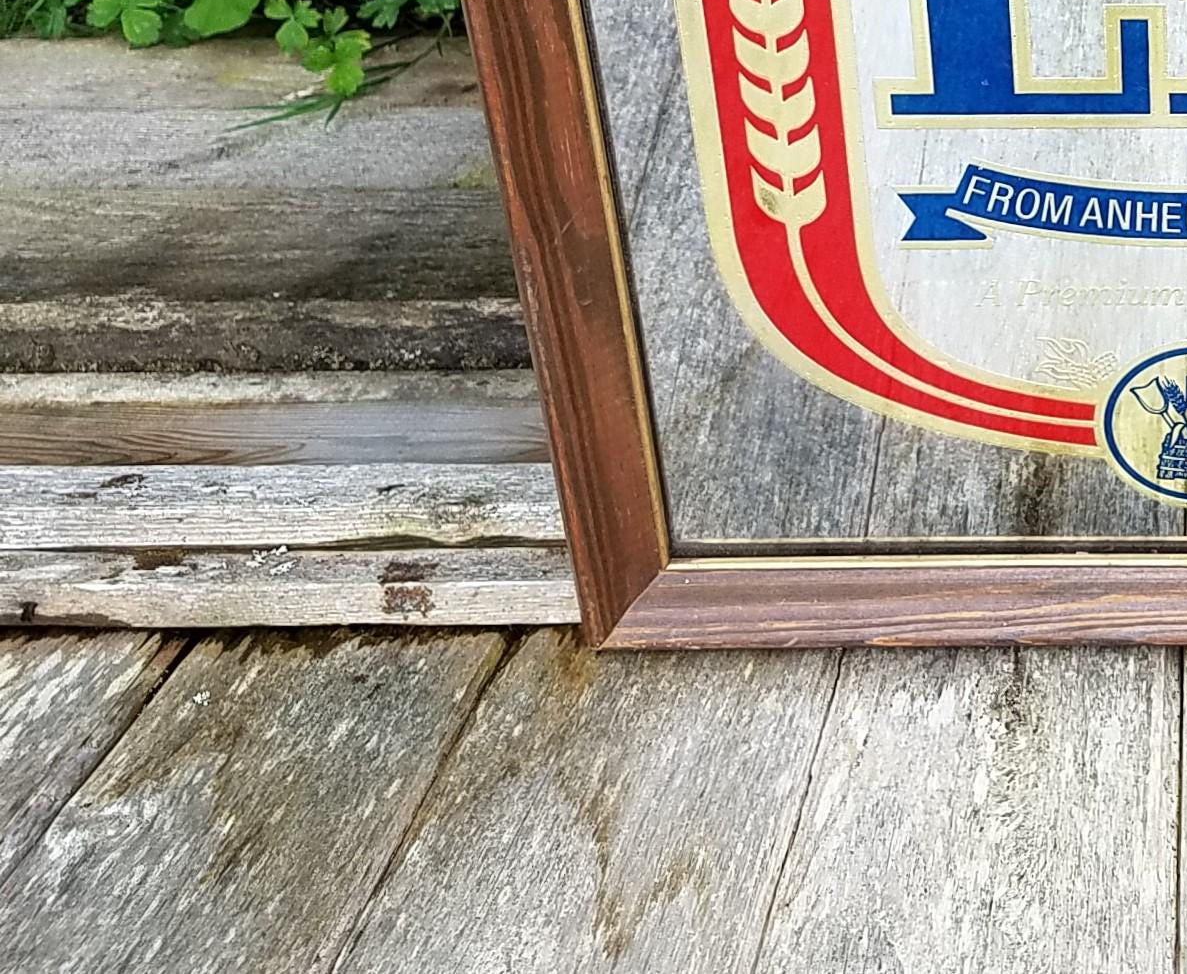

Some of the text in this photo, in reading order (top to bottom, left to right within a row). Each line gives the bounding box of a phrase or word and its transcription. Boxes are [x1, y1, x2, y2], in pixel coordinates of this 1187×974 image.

[963, 176, 1073, 226] FROM
[975, 279, 1001, 307] A
[1015, 278, 1186, 307] Premium
